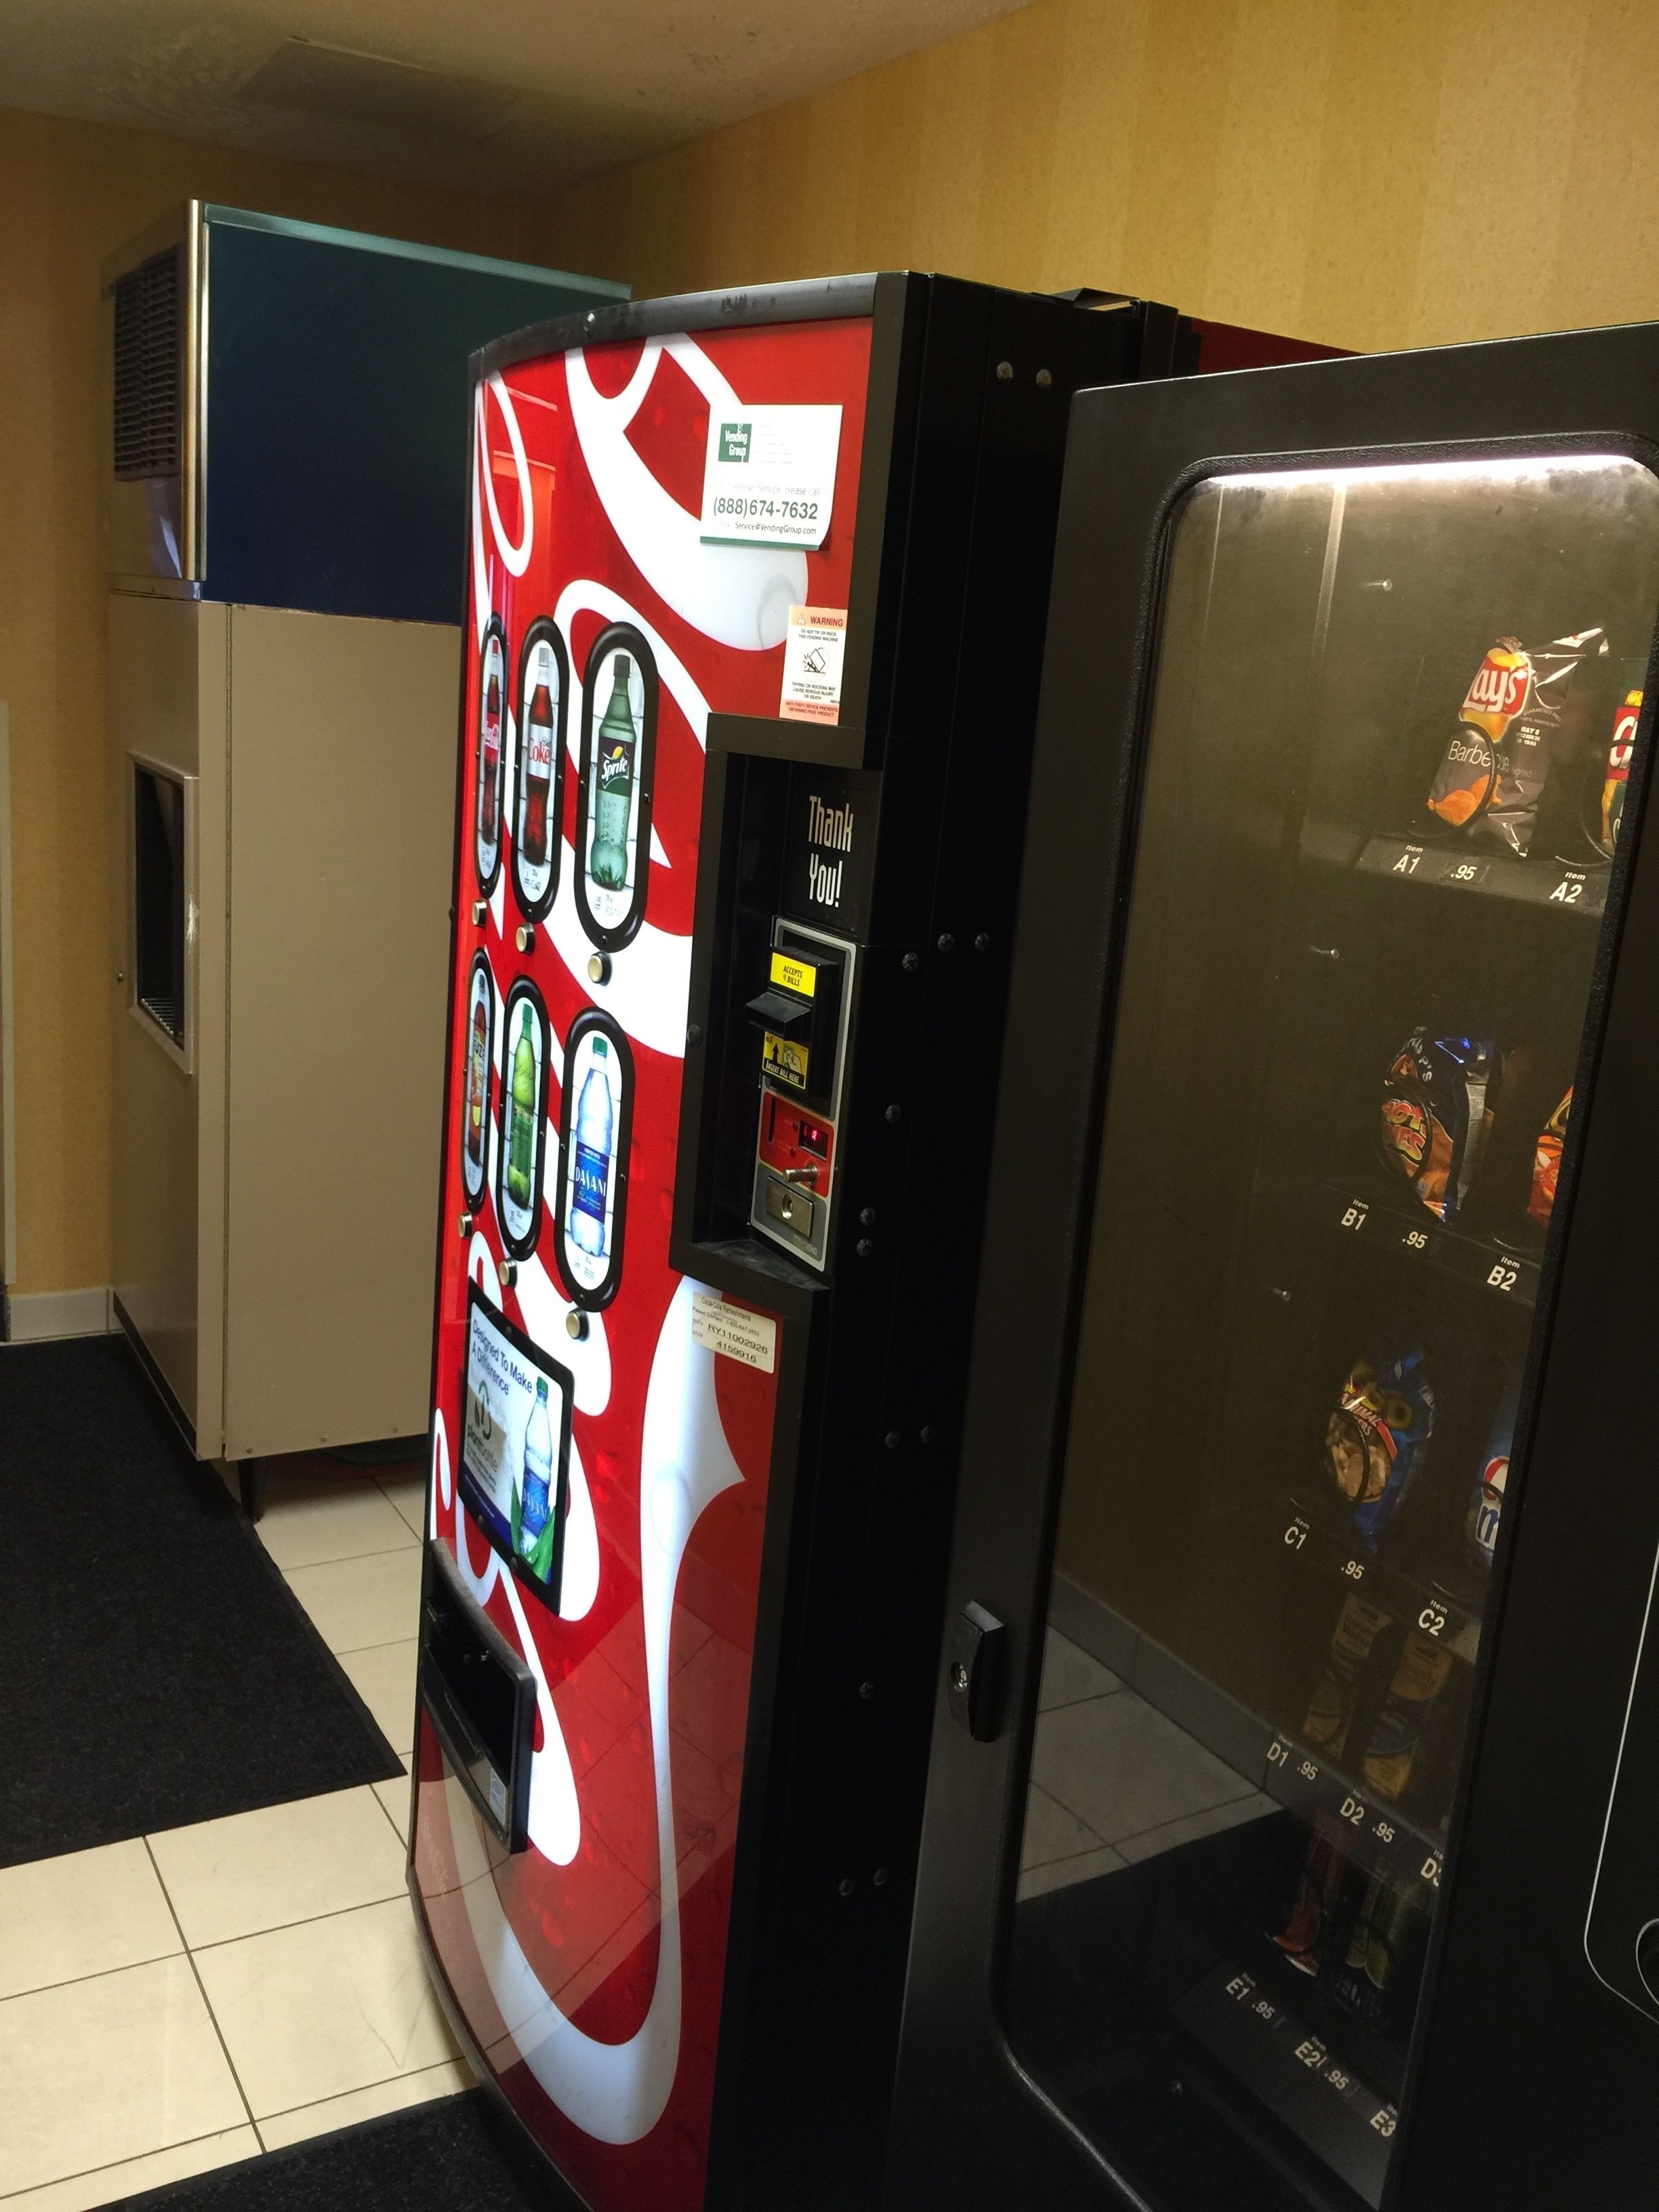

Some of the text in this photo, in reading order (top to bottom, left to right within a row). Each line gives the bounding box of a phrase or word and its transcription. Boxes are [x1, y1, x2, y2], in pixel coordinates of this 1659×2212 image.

[725, 430, 747, 445] Vending
[729, 443, 746, 457] Group
[735, 521, 817, 535] Service@VendingGroup.com
[810, 616, 843, 627] WARNING
[601, 757, 628, 781] Sprite
[808, 795, 854, 852] Thank
[809, 853, 843, 907] You!
[1393, 855, 1478, 880] A1 .95
[1549, 882, 1583, 904] A2
[783, 965, 803, 978] ACCEPTS
[787, 976, 800, 987] BILLS
[779, 1067, 788, 1079] BILL
[789, 1072, 800, 1083] HERE
[575, 1166, 607, 1197] DASANI
[1340, 1208, 1429, 1249] B1 .95
[1487, 1265, 1517, 1291] B2
[708, 1324, 768, 1355] RY11002926
[716, 1341, 756, 1364] 4159916
[472, 1319, 532, 1394] Designed To Make
[472, 1340, 509, 1395] A Difference
[1284, 1526, 1365, 1580] C1 .95
[1418, 1609, 1446, 1636] C2
[1267, 1742, 1319, 1780] D1 .95
[1340, 1797, 1396, 1843] D2 .95
[1226, 1977, 1275, 2020] E1 .95
[1295, 2041, 1350, 2091] E2 .95
[1370, 2110, 1396, 2137] E3
